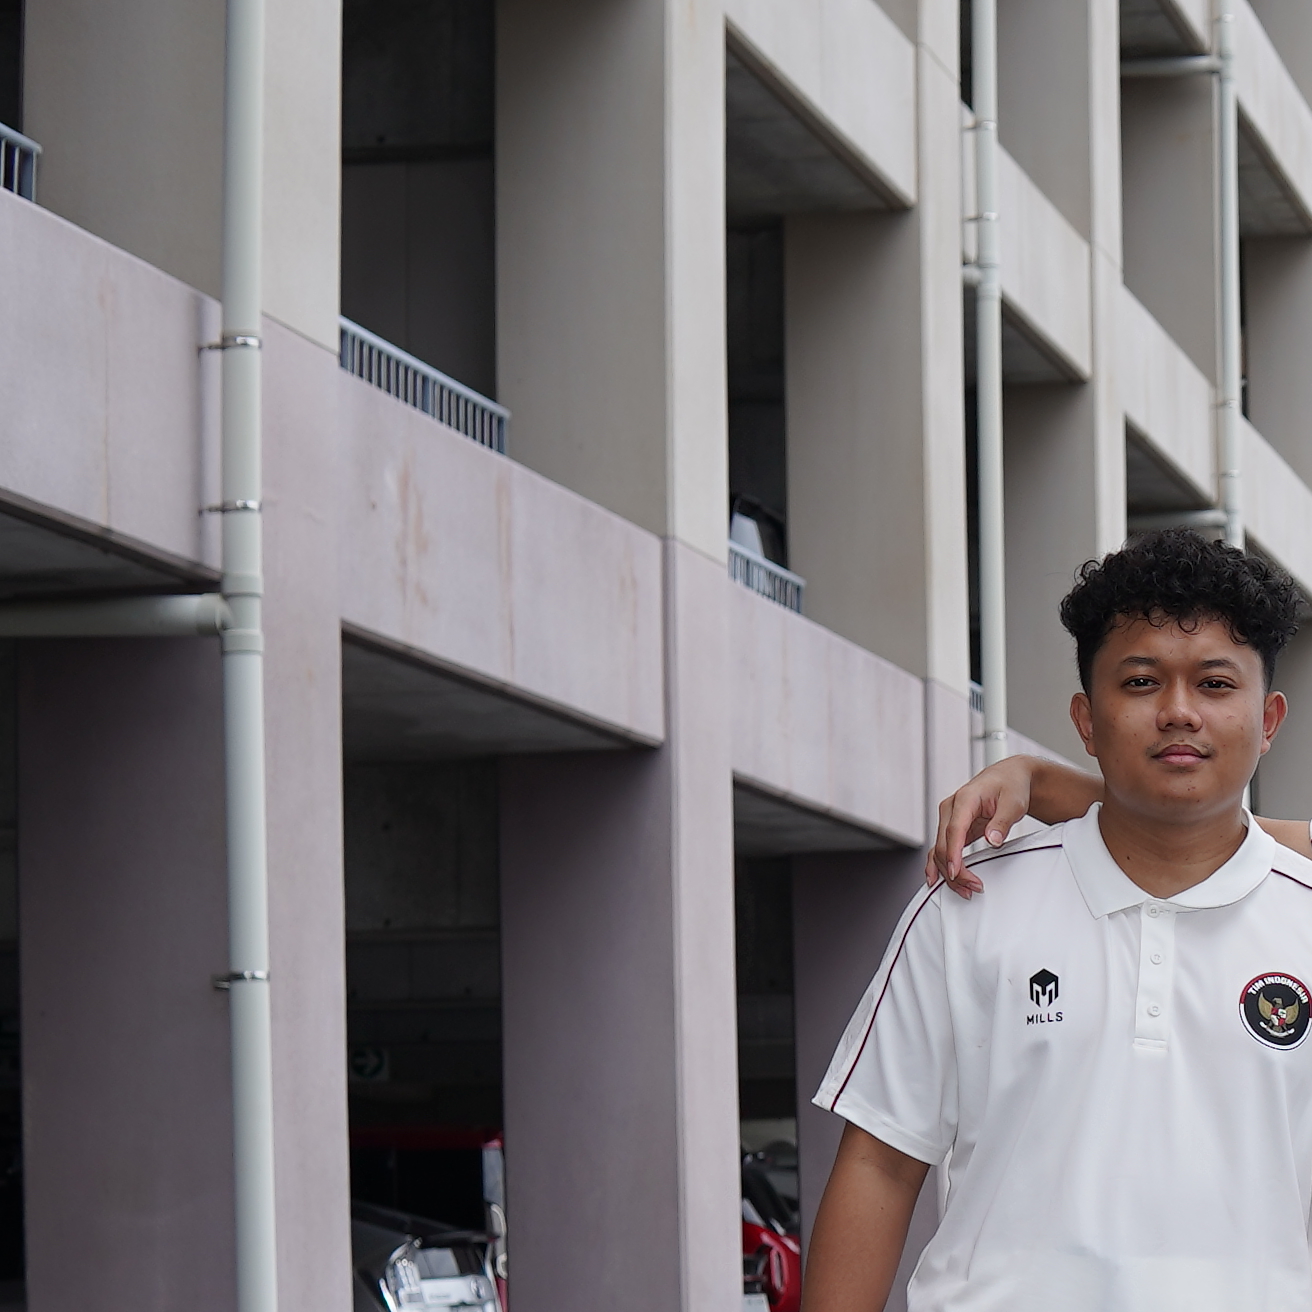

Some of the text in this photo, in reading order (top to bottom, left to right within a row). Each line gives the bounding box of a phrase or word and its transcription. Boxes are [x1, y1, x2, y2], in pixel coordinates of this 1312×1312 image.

[1247, 975, 1309, 1004] TIM INDONESIA
[1026, 1011, 1064, 1026] MILLS
